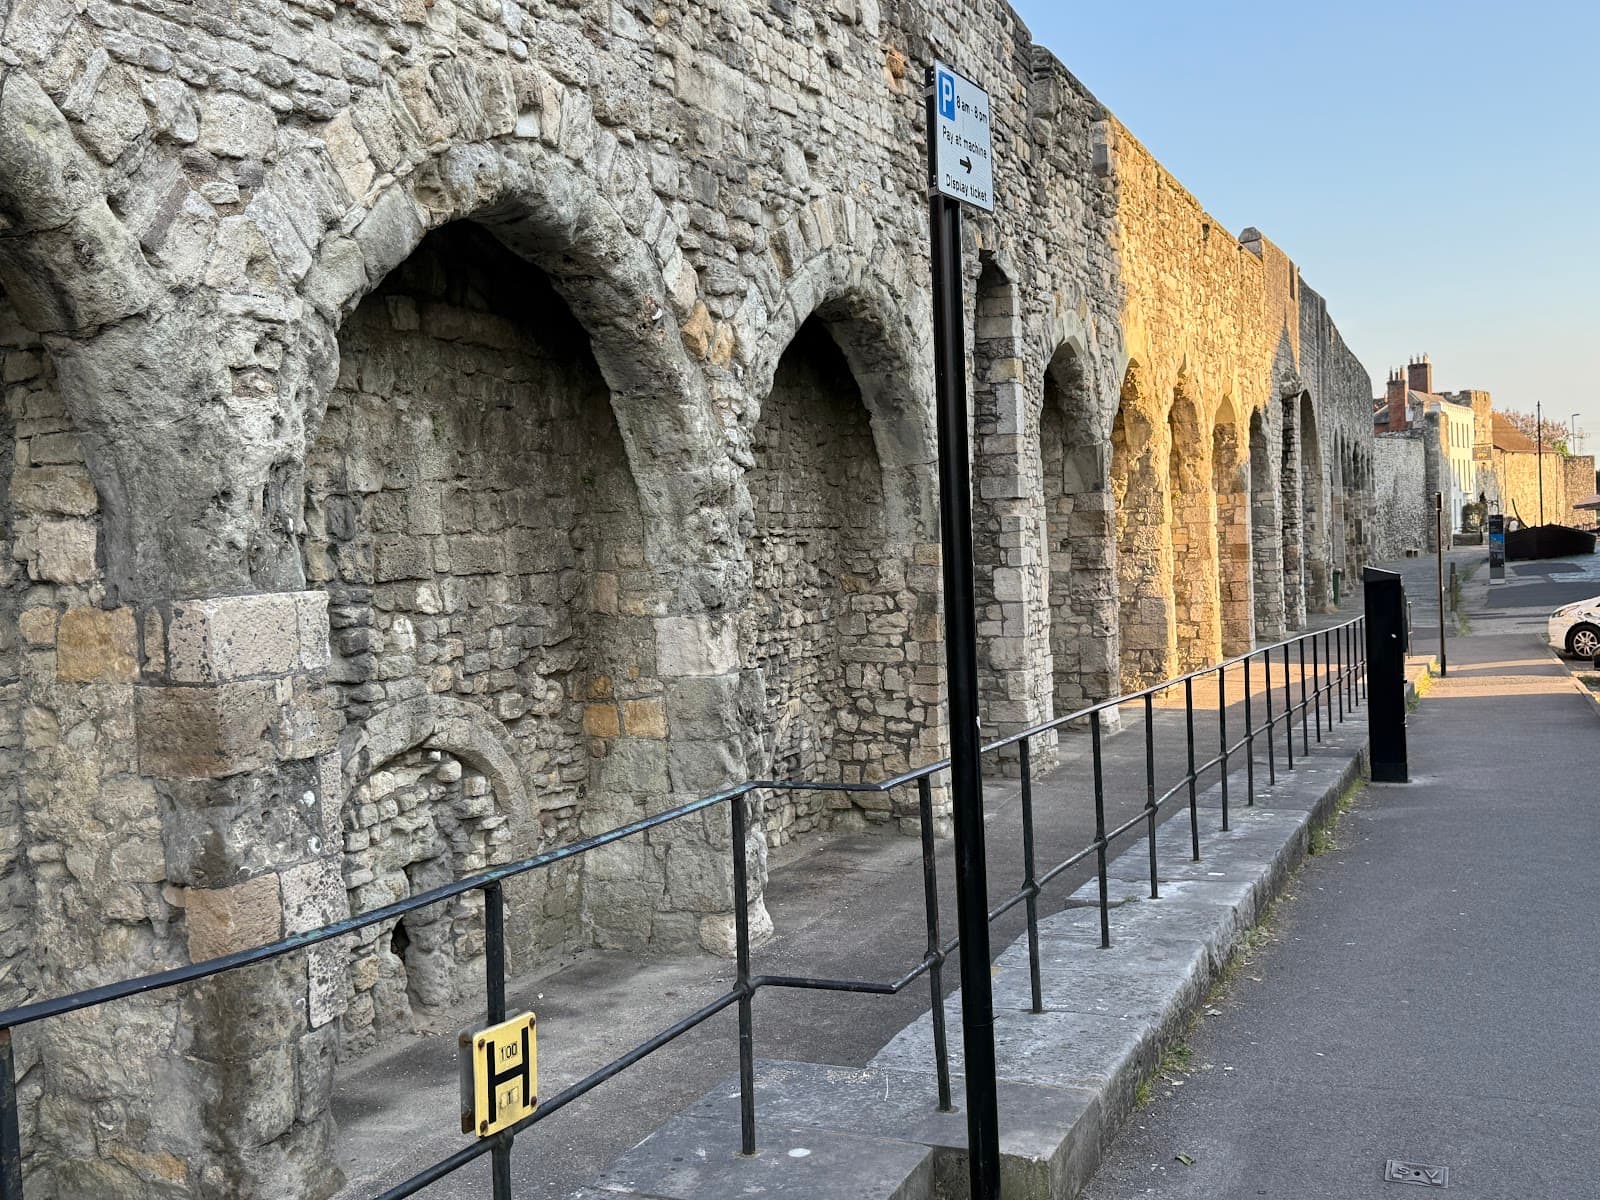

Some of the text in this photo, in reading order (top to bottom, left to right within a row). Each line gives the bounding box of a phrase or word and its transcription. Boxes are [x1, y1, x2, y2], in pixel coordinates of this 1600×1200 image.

[942, 77, 953, 113] P
[943, 125, 987, 159] Pay at machine
[946, 173, 987, 203] Display ticket
[501, 1042, 518, 1062] 100
[486, 1026, 530, 1124] H
